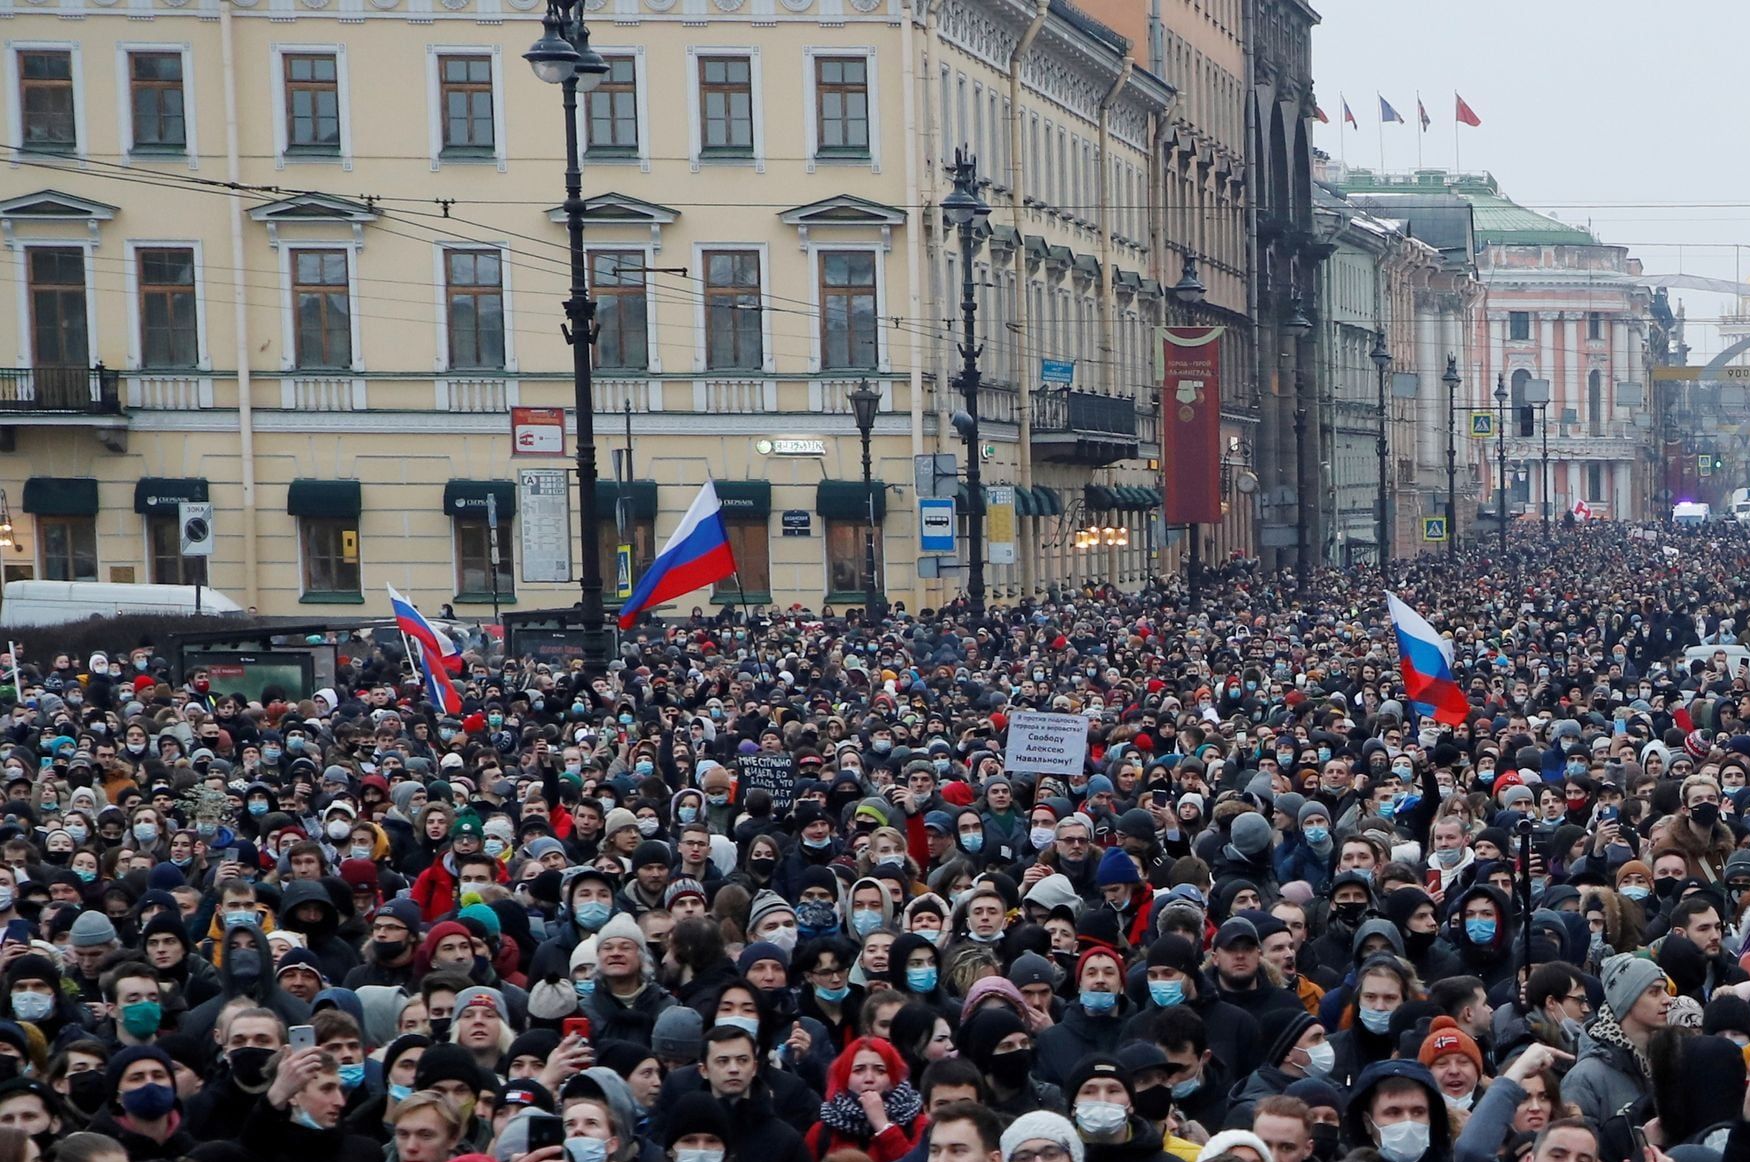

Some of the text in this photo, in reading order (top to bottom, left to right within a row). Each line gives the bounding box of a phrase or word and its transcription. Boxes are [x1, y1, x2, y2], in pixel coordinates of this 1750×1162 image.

[1028, 733, 1064, 744] Свободу
[1026, 744, 1064, 754] Алексею
[738, 756, 758, 766] МНЕ
[1016, 754, 1073, 766] Навальному!
[779, 779, 793, 787] ЧТО
